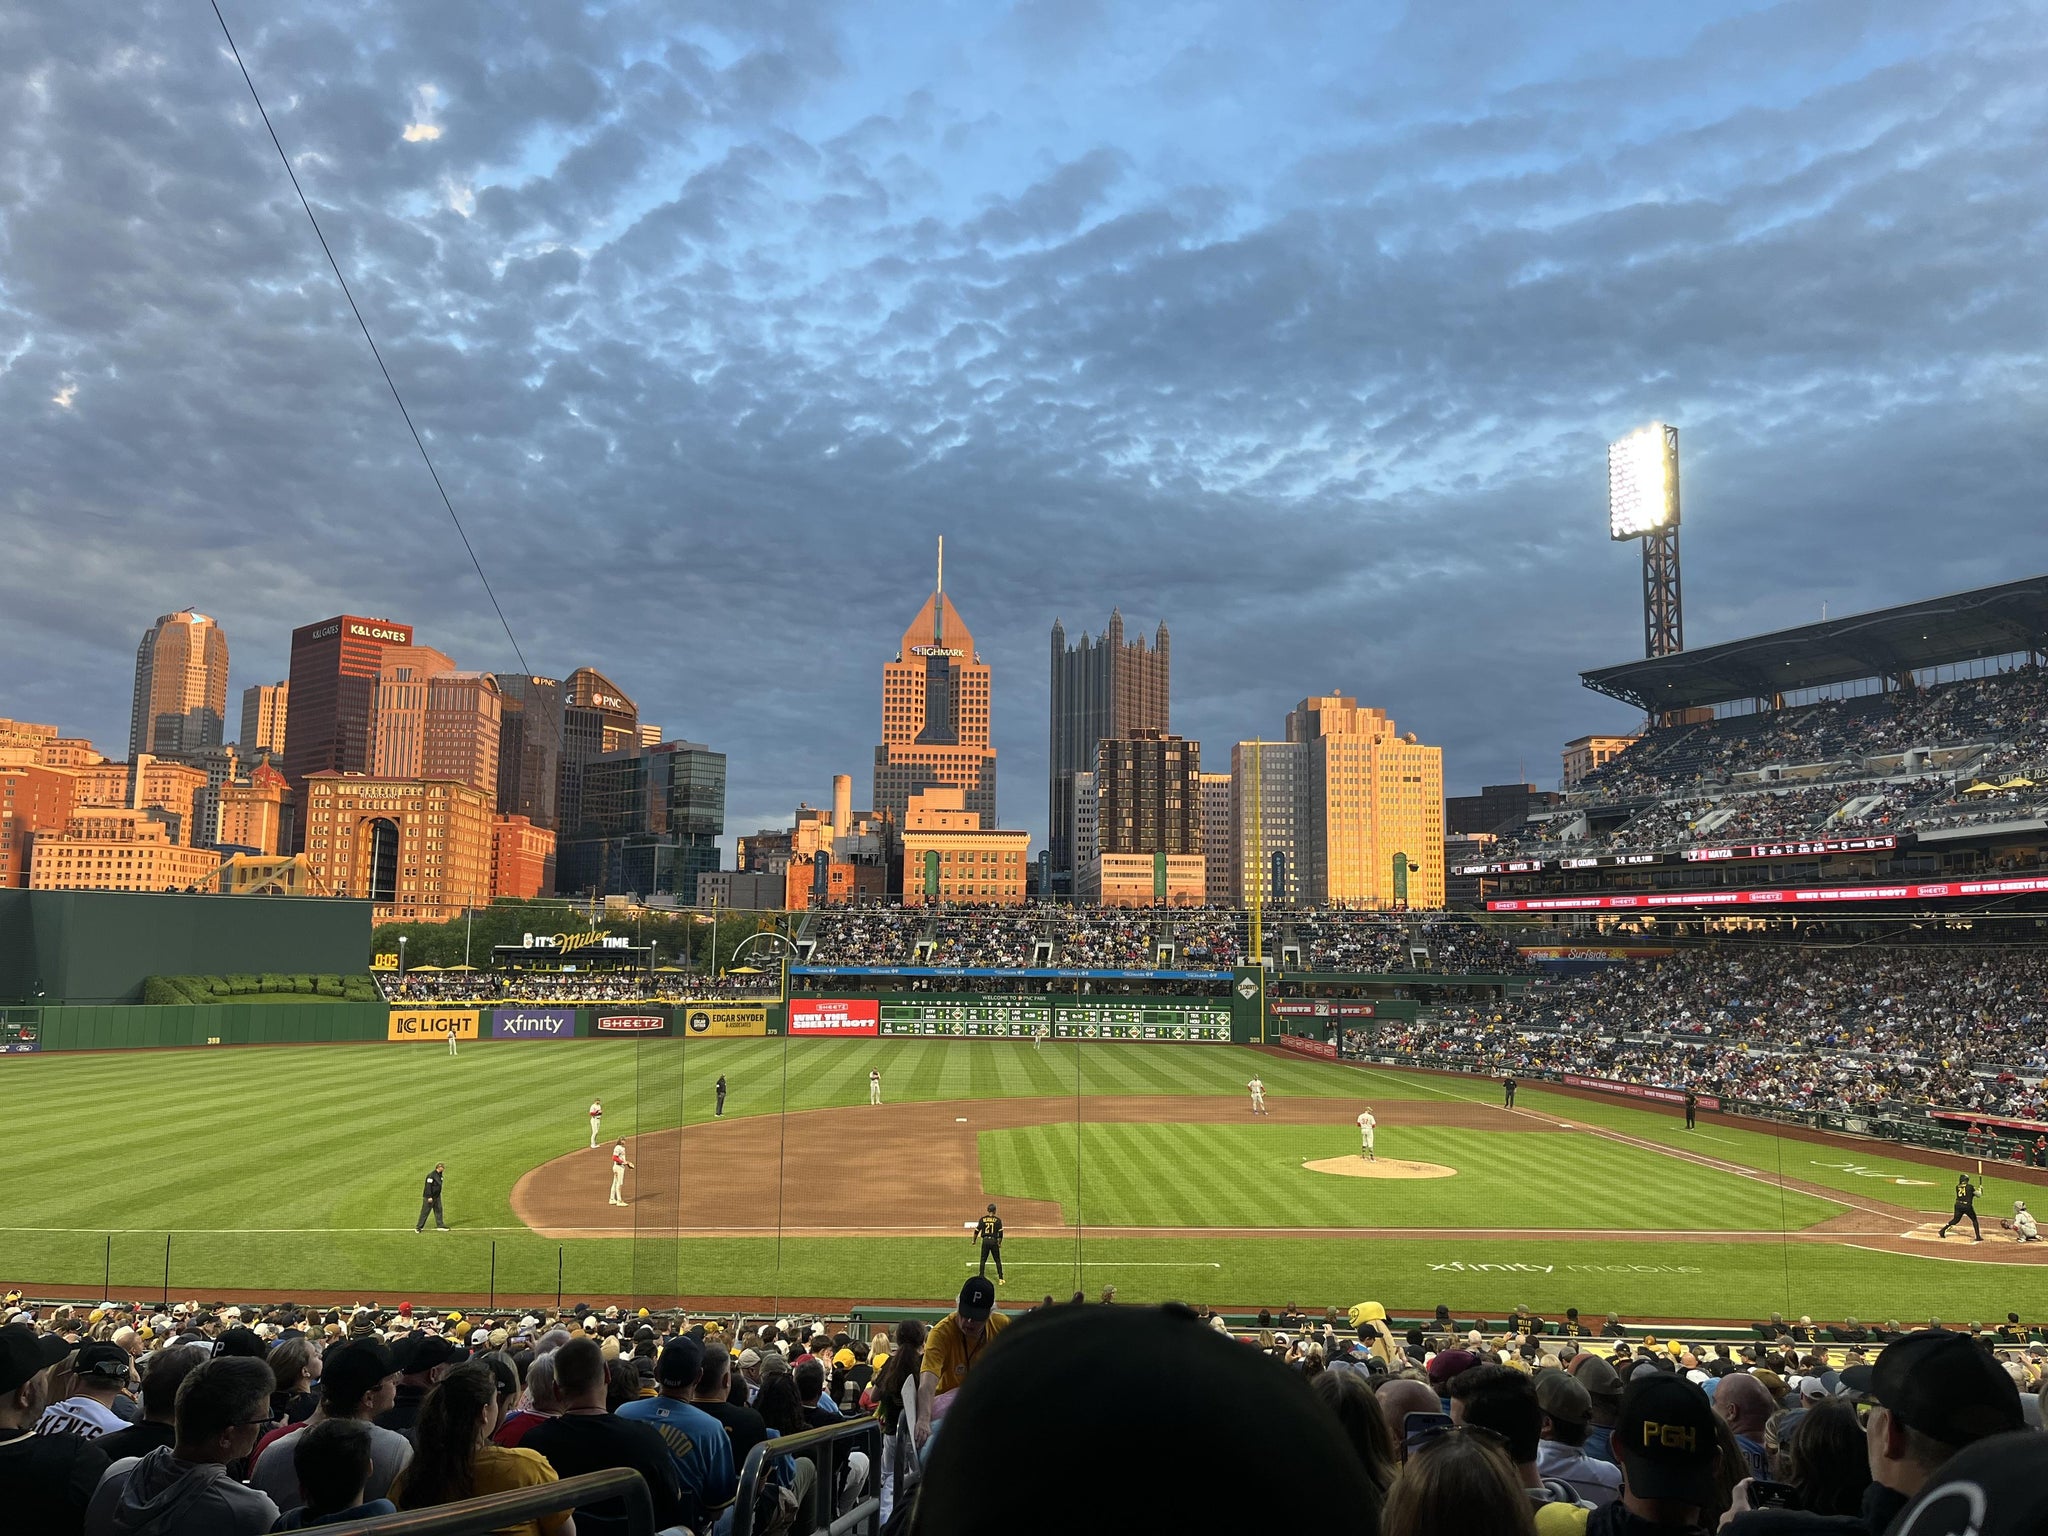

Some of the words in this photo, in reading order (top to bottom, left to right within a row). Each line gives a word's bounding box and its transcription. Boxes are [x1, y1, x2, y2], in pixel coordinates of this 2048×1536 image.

[312, 630, 322, 639] K&L
[322, 624, 339, 637] GATES
[350, 624, 370, 636] K&L
[372, 628, 406, 642] GATES
[917, 648, 964, 658] HIGHMARK
[540, 678, 556, 687] PNC
[565, 694, 574, 704] NC
[602, 696, 622, 708] PNC
[1998, 771, 2031, 784] WIGLE
[2034, 767, 2048, 780] RE
[1841, 842, 1848, 850] 5
[1866, 840, 1875, 848] 10
[1885, 838, 1893, 847] 15
[1708, 849, 1732, 859] MAYZA
[1509, 863, 1528, 871] MAYZA
[1919, 886, 1947, 894] SHEETZ
[2000, 882, 2034, 890] SHEETZ
[1840, 890, 1878, 898] SHEETZ
[1878, 888, 1906, 896] NOT?
[534, 936, 555, 948] IT'S
[552, 930, 612, 955] Miller
[602, 936, 630, 948] TIME
[1568, 948, 1607, 960] Surfside
[375, 953, 398, 966] 0:05
[603, 1018, 659, 1028] SHEETZ
[712, 1014, 735, 1022] EDGAR
[737, 1014, 764, 1022] SNYDER
[793, 1014, 822, 1022] WHY
[396, 1018, 416, 1034] IC
[420, 1018, 472, 1032] LIGHT
[504, 1014, 564, 1034] xfinity
[792, 1020, 840, 1028] SHEETZ
[842, 1020, 875, 1028] NOT?
[1958, 1186, 1966, 1196] 24
[984, 1222, 994, 1234] 27
[1426, 1261, 1554, 1273] xfinity
[1567, 1264, 1702, 1274] mobile
[973, 1292, 982, 1302] P
[213, 1342, 225, 1358] P
[34, 1414, 104, 1440] KENES
[1644, 1420, 1696, 1454] PGH
